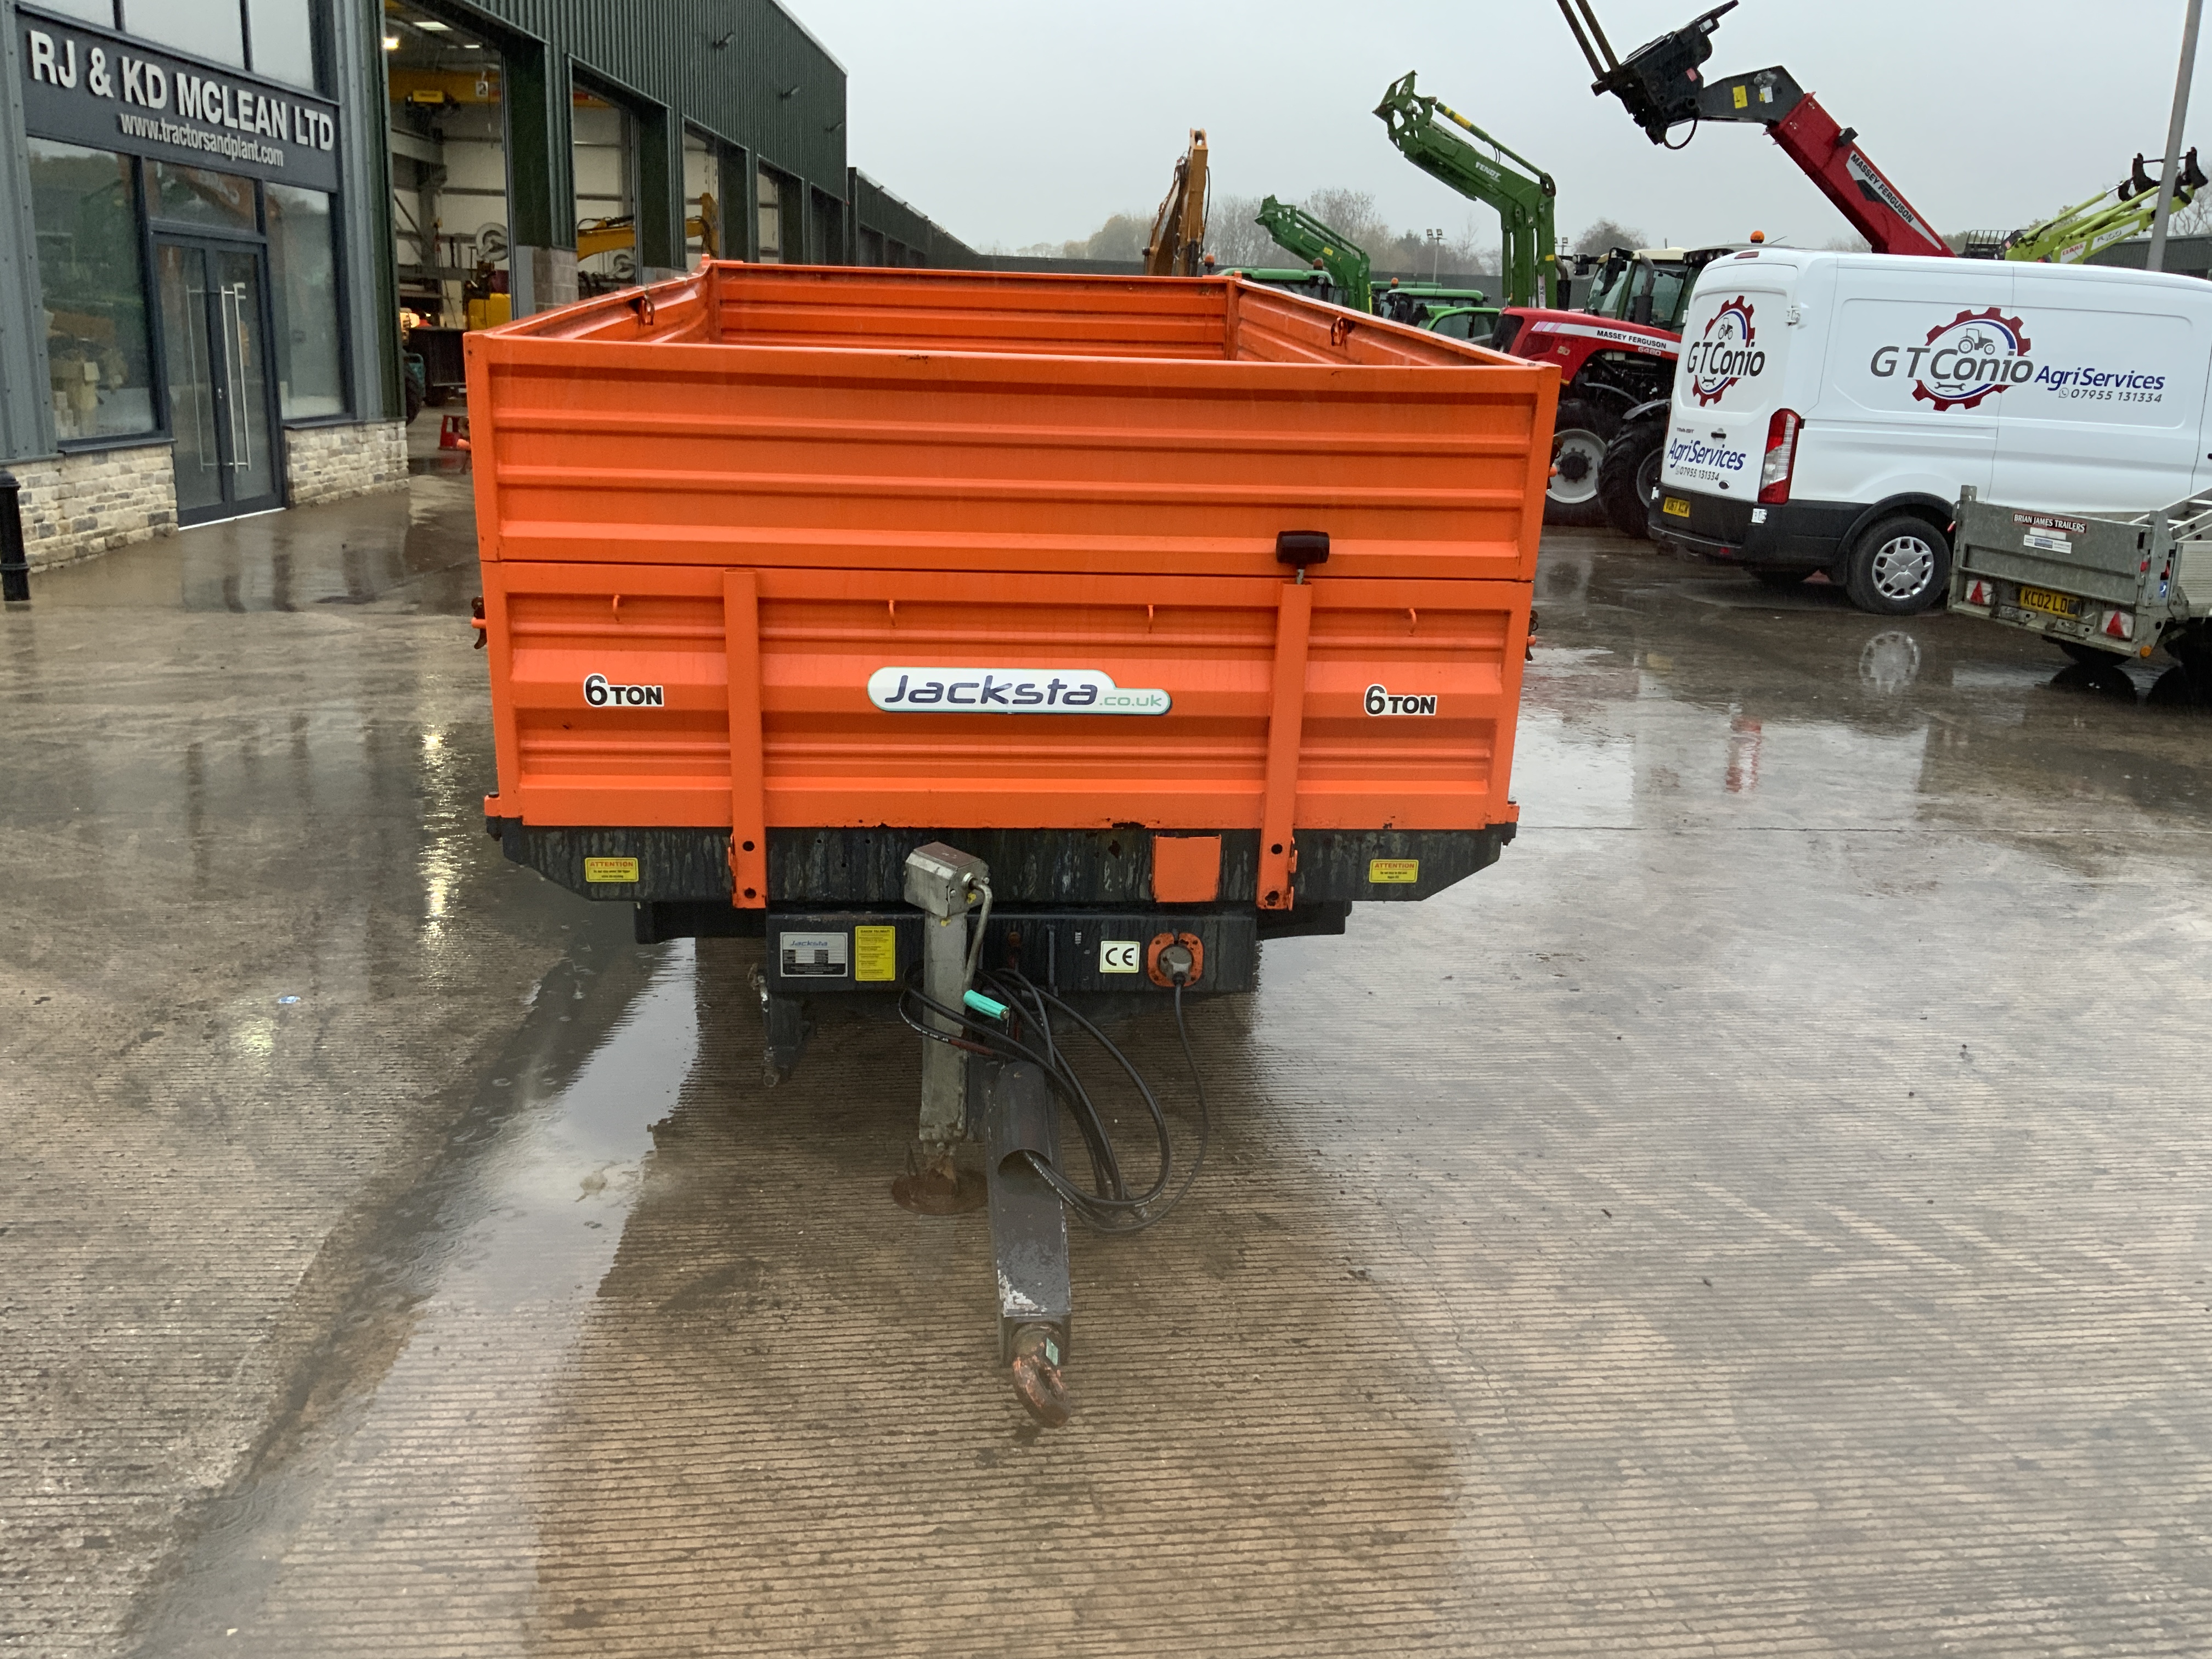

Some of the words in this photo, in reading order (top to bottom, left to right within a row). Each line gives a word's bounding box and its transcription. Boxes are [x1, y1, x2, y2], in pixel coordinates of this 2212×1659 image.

[31, 30, 77, 88] RJ
[89, 47, 115, 98] &
[122, 56, 167, 110] KD
[176, 72, 289, 141] MCLEAN
[294, 105, 335, 151] LTD
[120, 112, 284, 167] www.tractorsandplant.com
[1850, 154, 1880, 185] MASSEY
[1878, 183, 1914, 223] FERGUSON
[1597, 330, 1627, 341] MASSEY
[1628, 335, 1666, 349] FERGUSON
[1638, 346, 1661, 356] 6480
[2071, 388, 2113, 400] 07955
[2118, 392, 2163, 403] 131334
[1679, 466, 1696, 477] 07955
[1699, 470, 1719, 481] 131334
[2014, 514, 2032, 523] BRIAN
[2033, 517, 2053, 527] JAMES
[2055, 520, 2085, 533] TRAILERS
[2024, 589, 2051, 609] KC02
[1105, 947, 1135, 967] CE
